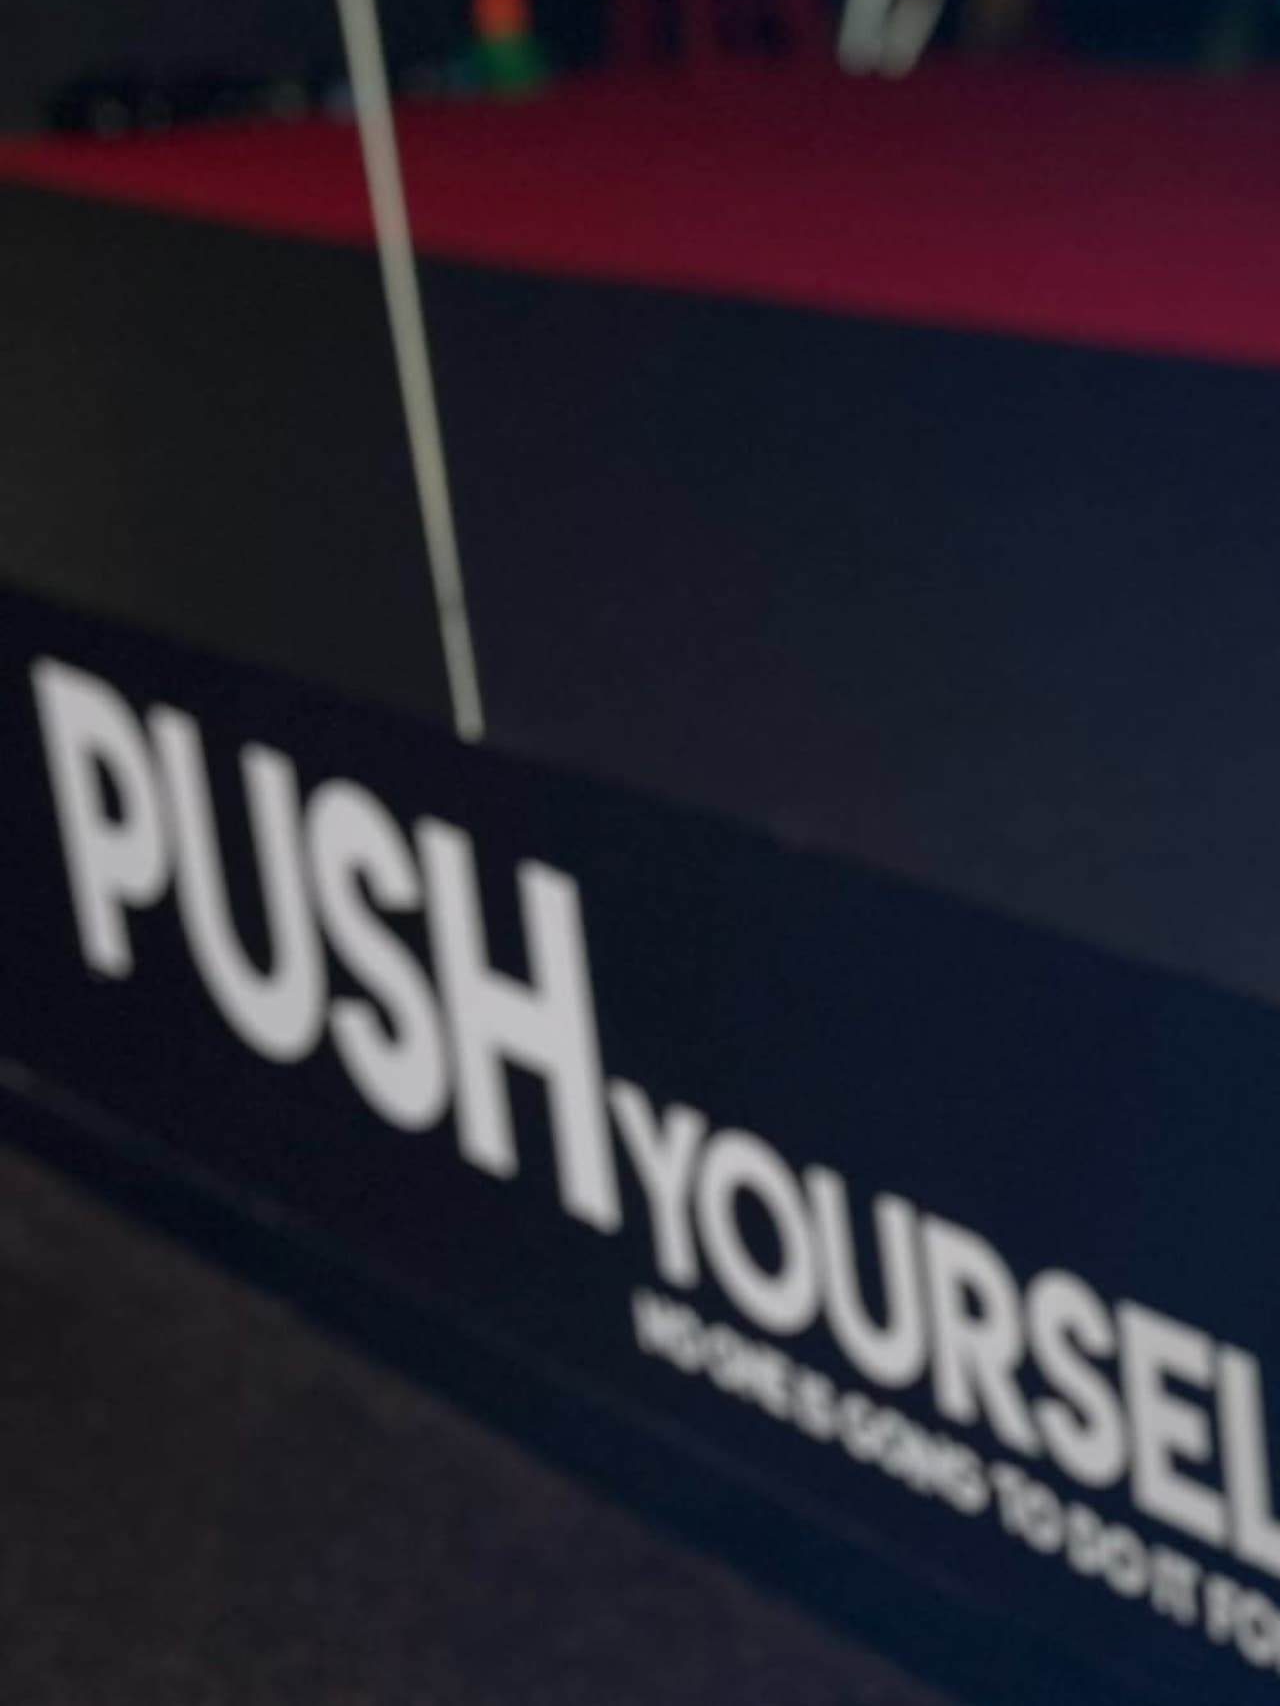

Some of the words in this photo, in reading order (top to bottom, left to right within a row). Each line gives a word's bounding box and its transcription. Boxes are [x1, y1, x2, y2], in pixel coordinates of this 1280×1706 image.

[31, 655, 622, 1234] PUSH
[990, 1461, 1065, 1556] TO
[1065, 1502, 1148, 1600] DO
[1147, 1544, 1203, 1627] IT
